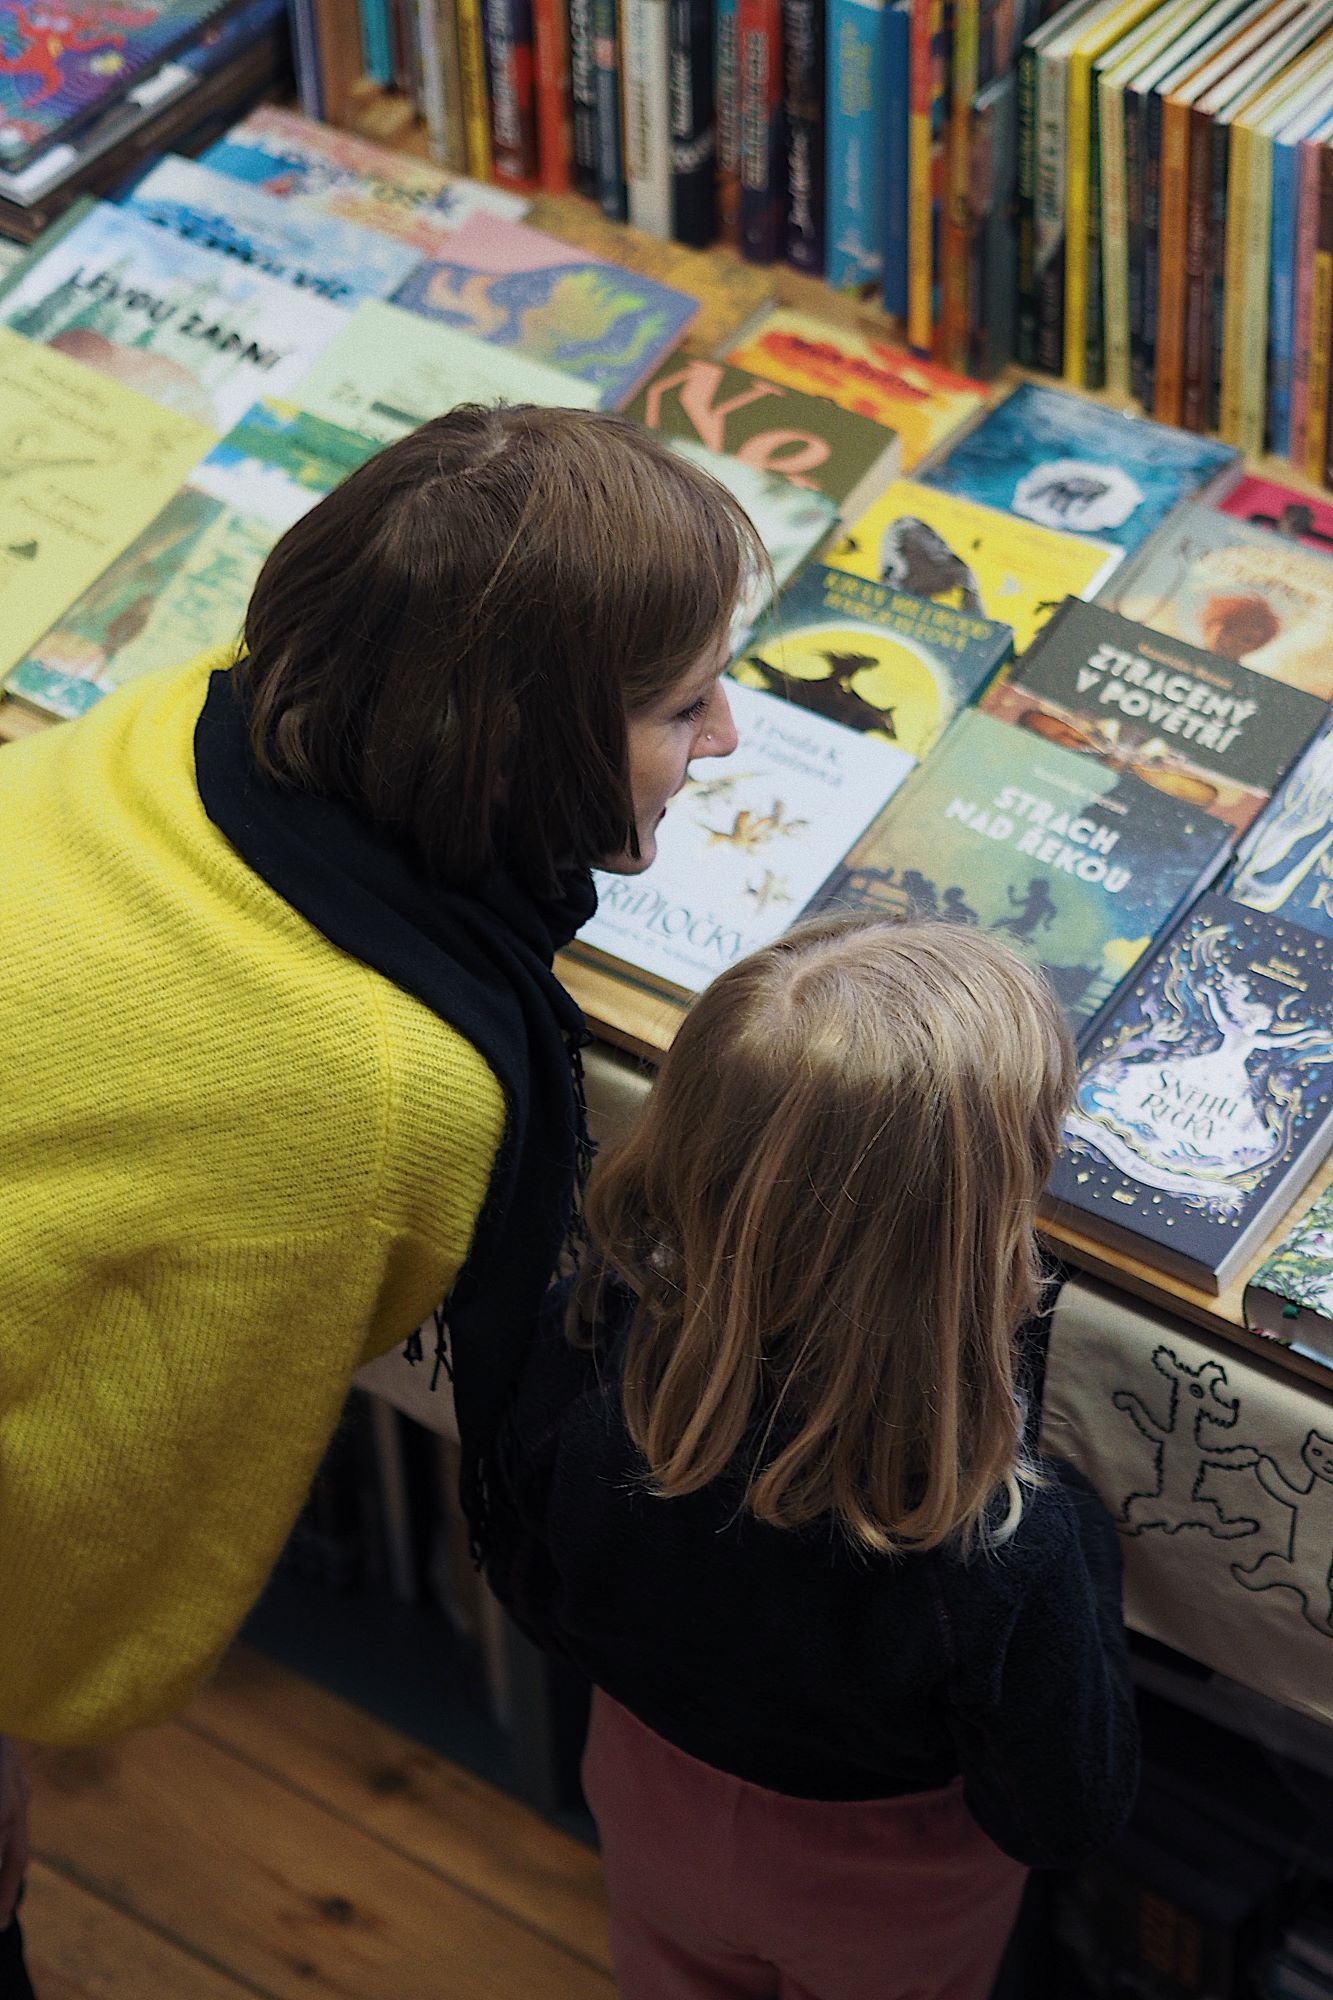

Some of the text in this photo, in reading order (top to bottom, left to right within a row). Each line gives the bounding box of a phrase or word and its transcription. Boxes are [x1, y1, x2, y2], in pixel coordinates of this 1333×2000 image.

[1076, 666, 1101, 694] V
[1099, 679, 1242, 754] POVĚTŘÍ
[1087, 643, 1258, 727] ZTRACENÝ
[944, 797, 1133, 894] NAD ŘEKOU
[991, 785, 1121, 855] STRACH
